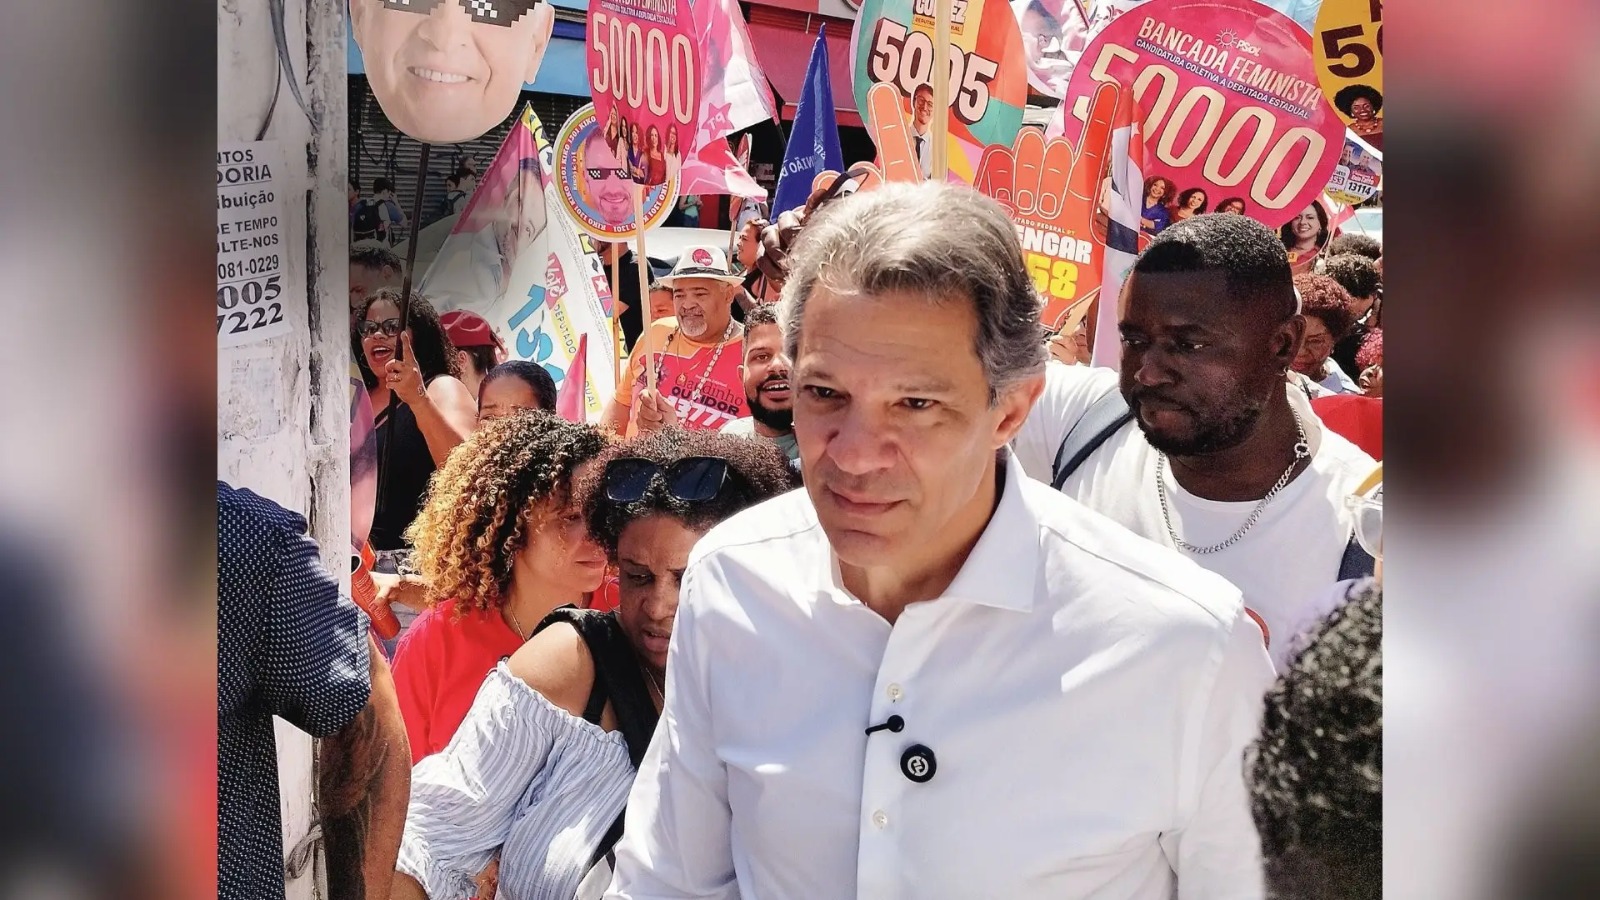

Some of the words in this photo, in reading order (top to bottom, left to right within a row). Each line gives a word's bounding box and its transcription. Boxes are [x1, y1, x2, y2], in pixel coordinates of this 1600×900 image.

[593, 12, 694, 124] 50000
[1136, 39, 1184, 66] CANDIDATURA
[1186, 62, 1219, 83] COLETIVA
[1220, 78, 1227, 86] A
[1227, 81, 1268, 103] DEPUTADA
[1269, 98, 1309, 119] ESTADUAL
[1138, 17, 1229, 73] BANCADA
[1228, 56, 1323, 111] FEMINISTA
[578, 115, 597, 129] KIKO
[1348, 182, 1372, 195] 13114
[235, 216, 277, 232] TEMPO
[1037, 222, 1066, 234] FEDERAL
[218, 254, 279, 279] 081-0229
[1027, 253, 1079, 300] 58
[217, 275, 281, 309] 005
[553, 303, 577, 354] DEPUTADO
